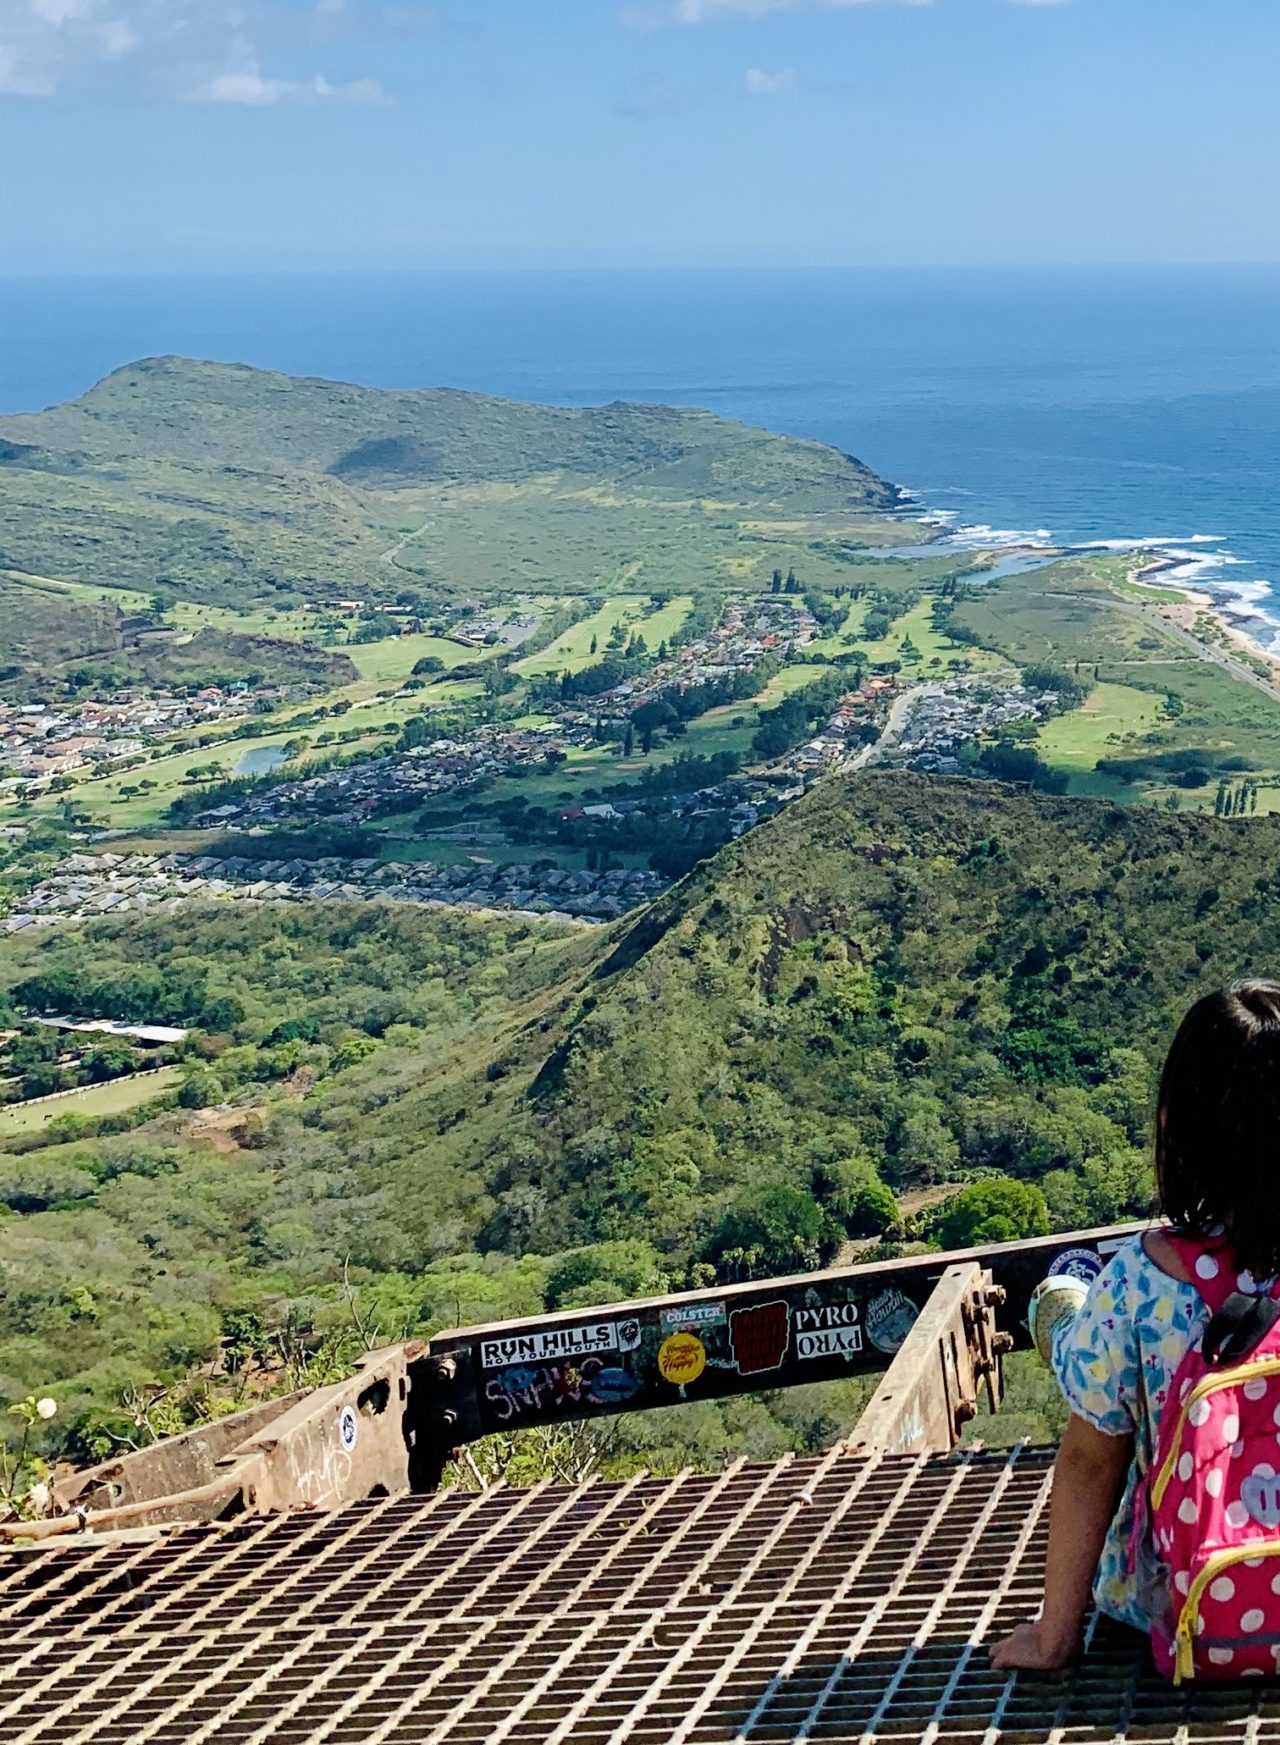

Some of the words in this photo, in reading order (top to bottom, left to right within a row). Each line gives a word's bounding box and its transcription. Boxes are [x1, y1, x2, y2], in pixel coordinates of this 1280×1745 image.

[795, 1303, 859, 1330] PYRO
[484, 1338, 535, 1360] RUN
[542, 1326, 611, 1350] HILLS
[485, 1356, 514, 1366] NOT
[520, 1350, 556, 1361] YOUR
[564, 1340, 611, 1354] MOUTH
[798, 1330, 861, 1355] PYRO
